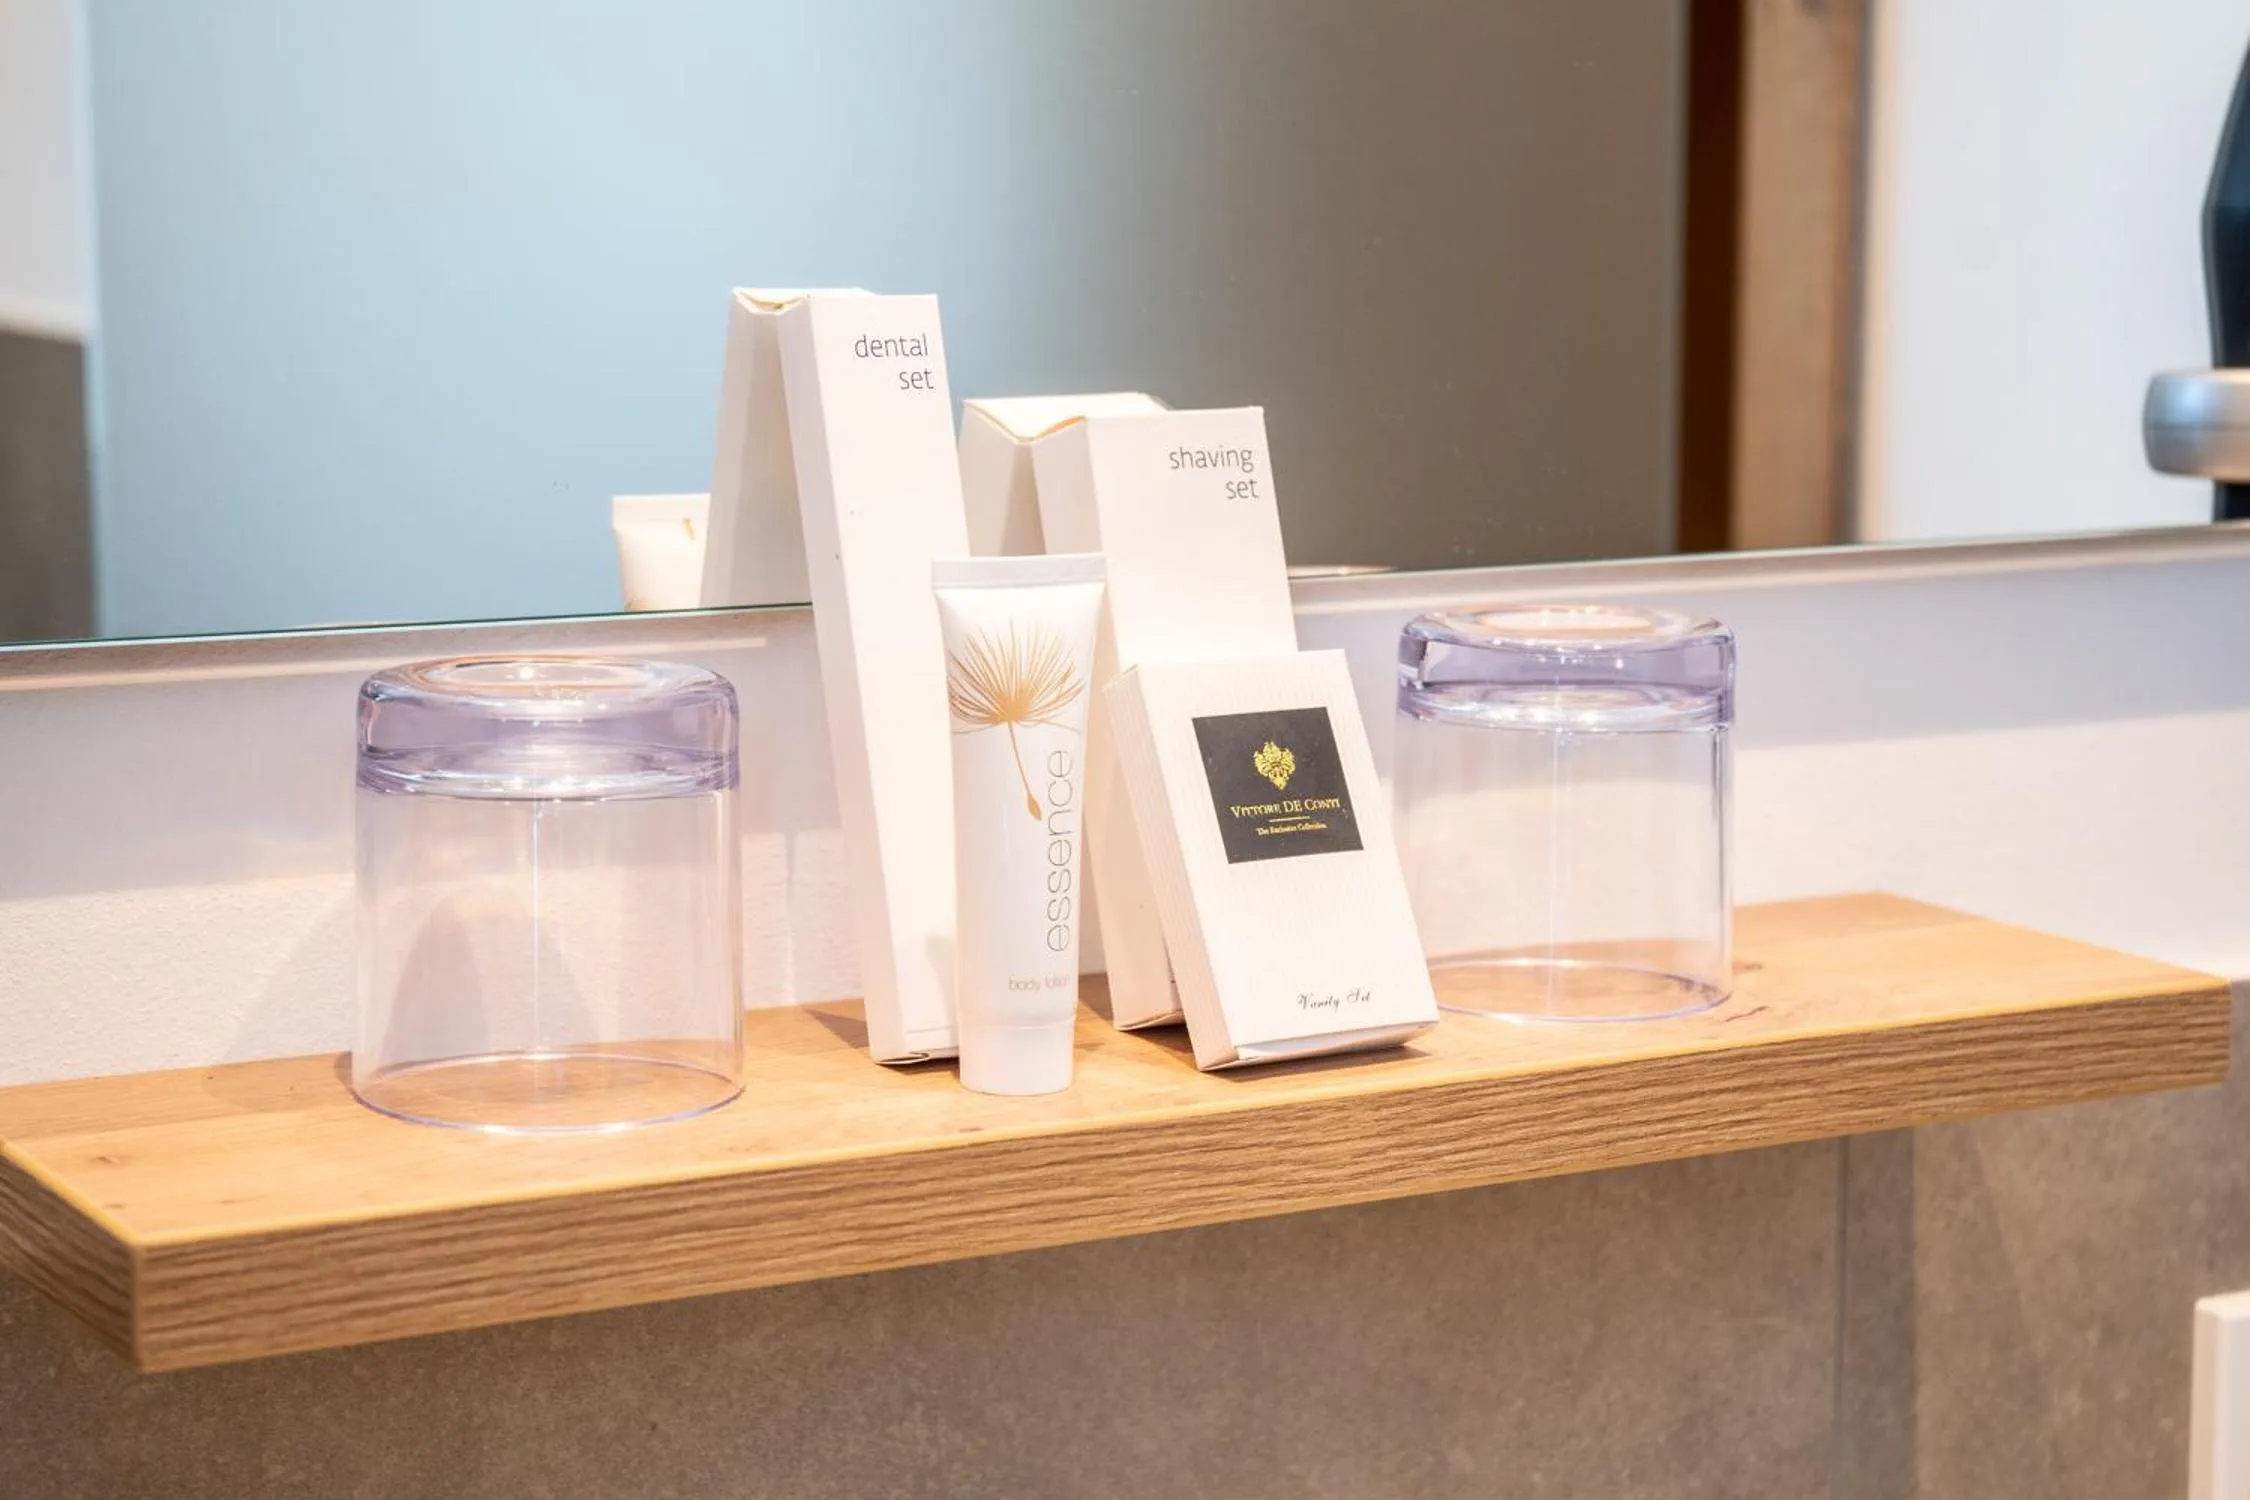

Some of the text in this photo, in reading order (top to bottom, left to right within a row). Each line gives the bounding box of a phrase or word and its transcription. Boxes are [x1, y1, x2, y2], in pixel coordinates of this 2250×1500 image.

[855, 333, 928, 358] dental
[899, 368, 934, 390] set
[1169, 445, 1254, 473] shaving
[1225, 479, 1260, 499] set
[1283, 800, 1302, 813] DE
[1304, 798, 1340, 811] CONTI
[1046, 750, 1073, 952] essence
[1008, 974, 1040, 994] body
